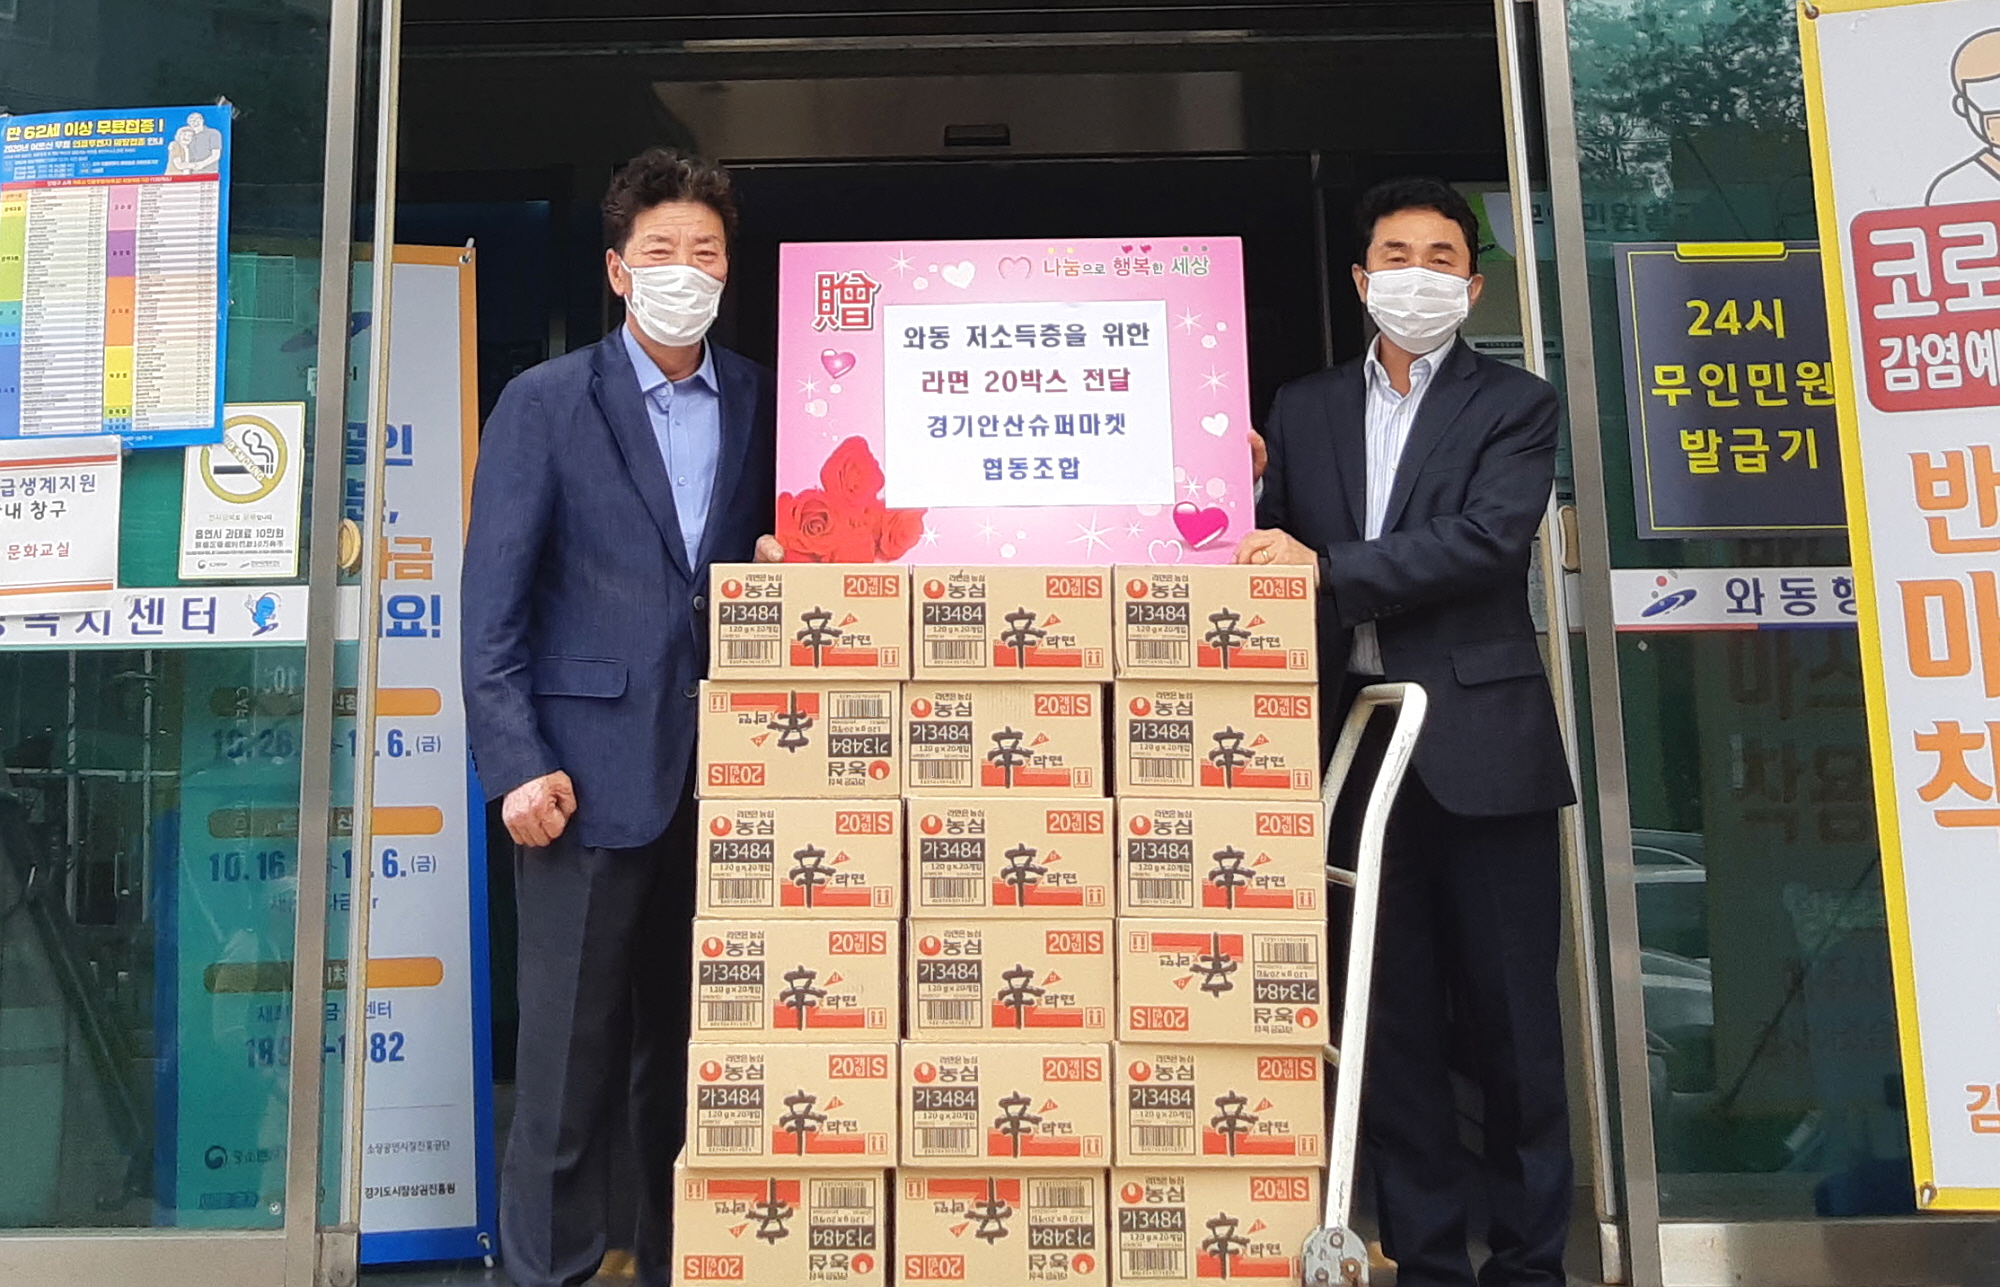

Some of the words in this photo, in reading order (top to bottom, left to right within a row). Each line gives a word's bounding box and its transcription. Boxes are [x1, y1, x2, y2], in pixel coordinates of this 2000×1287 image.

[23, 123, 60, 140] 62세
[64, 121, 93, 137] 이상
[97, 118, 155, 135] 무료접종
[1044, 257, 1106, 277] 나눔으로
[1113, 257, 1163, 277] 행복한
[1171, 256, 1208, 276] 세상
[814, 272, 877, 331] 贈
[1686, 298, 1785, 339] 24시
[904, 324, 951, 351] 와동
[966, 323, 1087, 348] 저소득층을
[1102, 321, 1150, 346] 위한
[921, 370, 969, 394] 라면
[985, 369, 1068, 393] 20박스
[1082, 367, 1131, 392] 전달
[1651, 360, 1836, 407] 무인민원
[927, 413, 1126, 439] 경기안산슈퍼마켓
[1679, 427, 1818, 474] 발급기
[983, 456, 1081, 481] 협동조합
[0, 474, 96, 497] 급생계지원
[0, 502, 21, 519] 내
[30, 500, 67, 520] 창구
[255, 527, 284, 538] 10만원
[7, 541, 70, 561] 문화교실
[744, 582, 782, 599] 농심
[948, 583, 985, 599] 농심
[1151, 582, 1189, 599] 농심
[722, 605, 779, 622] 가3484
[926, 605, 982, 622] 가3484
[1129, 605, 1186, 622] 가3484
[842, 634, 872, 647] 라면
[1047, 635, 1076, 648] 라면
[1251, 636, 1280, 650] 라면
[934, 701, 972, 718] 농심
[1155, 700, 1193, 717] 농심
[912, 724, 969, 741] 가3484
[1133, 722, 1190, 740] 가3484
[831, 737, 888, 754] 가3484
[828, 761, 866, 778] 농심
[1033, 755, 1063, 768] 라면
[1255, 755, 1285, 769] 라면
[735, 819, 774, 836] 농심
[946, 818, 985, 835] 농심
[1154, 819, 1193, 836] 농심
[713, 842, 771, 860] 가3484
[924, 841, 982, 859] 가3484
[1131, 842, 1190, 860] 가3484
[835, 873, 865, 887] 라면
[1047, 872, 1077, 886] 라면
[1255, 875, 1286, 889] 라면
[725, 939, 765, 957] 농심
[943, 939, 982, 956] 농심
[702, 963, 761, 982] 가3484
[920, 963, 979, 980] 가3484
[1256, 982, 1316, 1001] 가3484
[826, 995, 857, 1009] 라면
[1045, 994, 1076, 1008] 라면
[1253, 1007, 1294, 1025] 농심
[724, 1063, 764, 1081] 농심
[939, 1066, 978, 1083] 농심
[1155, 1064, 1194, 1081] 농심
[701, 1088, 760, 1107] 가3484
[916, 1090, 975, 1108] 가3484
[1132, 1088, 1191, 1106] 가3484
[827, 1120, 858, 1134] 라면
[1042, 1122, 1074, 1136] 라면
[1258, 1121, 1289, 1135] 라면
[1144, 1186, 1185, 1203] 농심
[1122, 1210, 1182, 1229] 가3484
[812, 1228, 872, 1247] 가3484
[1032, 1227, 1091, 1246] 가3484
[1252, 1242, 1283, 1257] 라면
[809, 1253, 849, 1271] 농심
[1029, 1253, 1069, 1271] 농심
